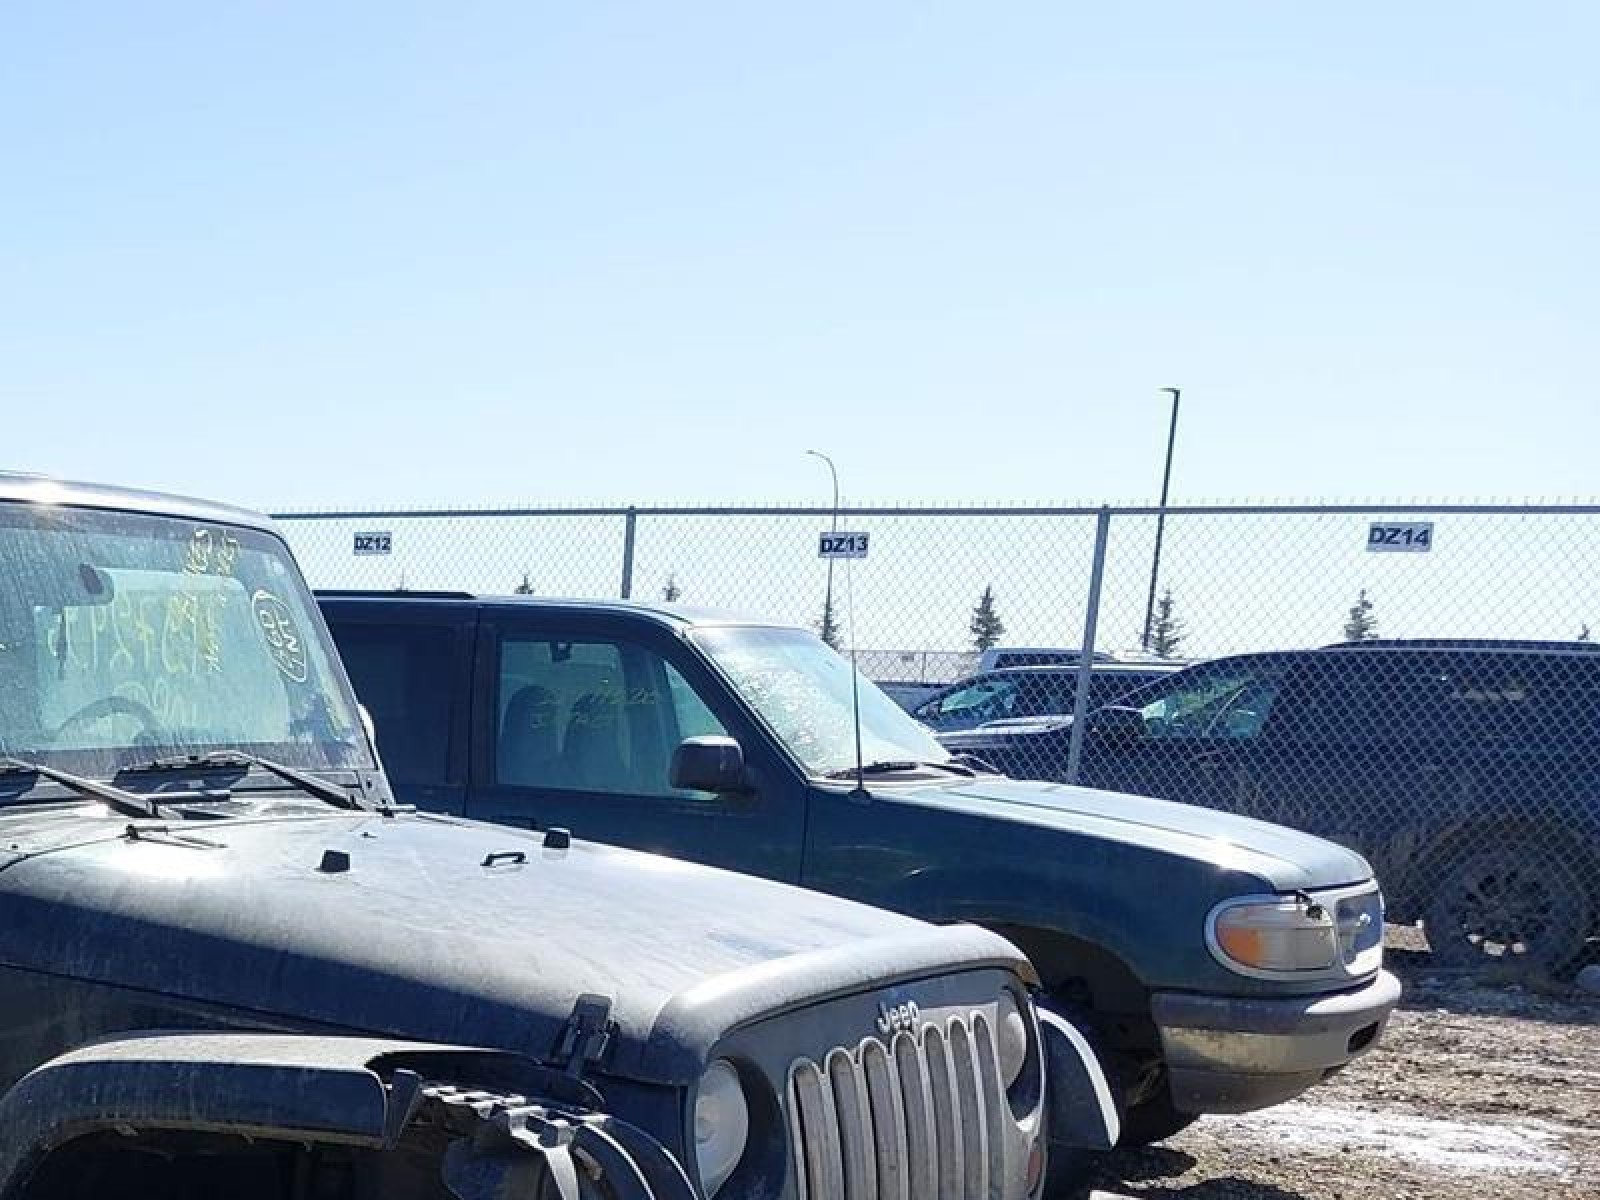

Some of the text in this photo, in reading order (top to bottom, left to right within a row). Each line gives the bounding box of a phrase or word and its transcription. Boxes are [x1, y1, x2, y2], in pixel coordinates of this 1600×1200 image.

[355, 536, 391, 551] DZ12
[821, 536, 868, 553] DZ13
[1368, 528, 1429, 546] DZ14
[878, 1000, 919, 1033] Jeep
